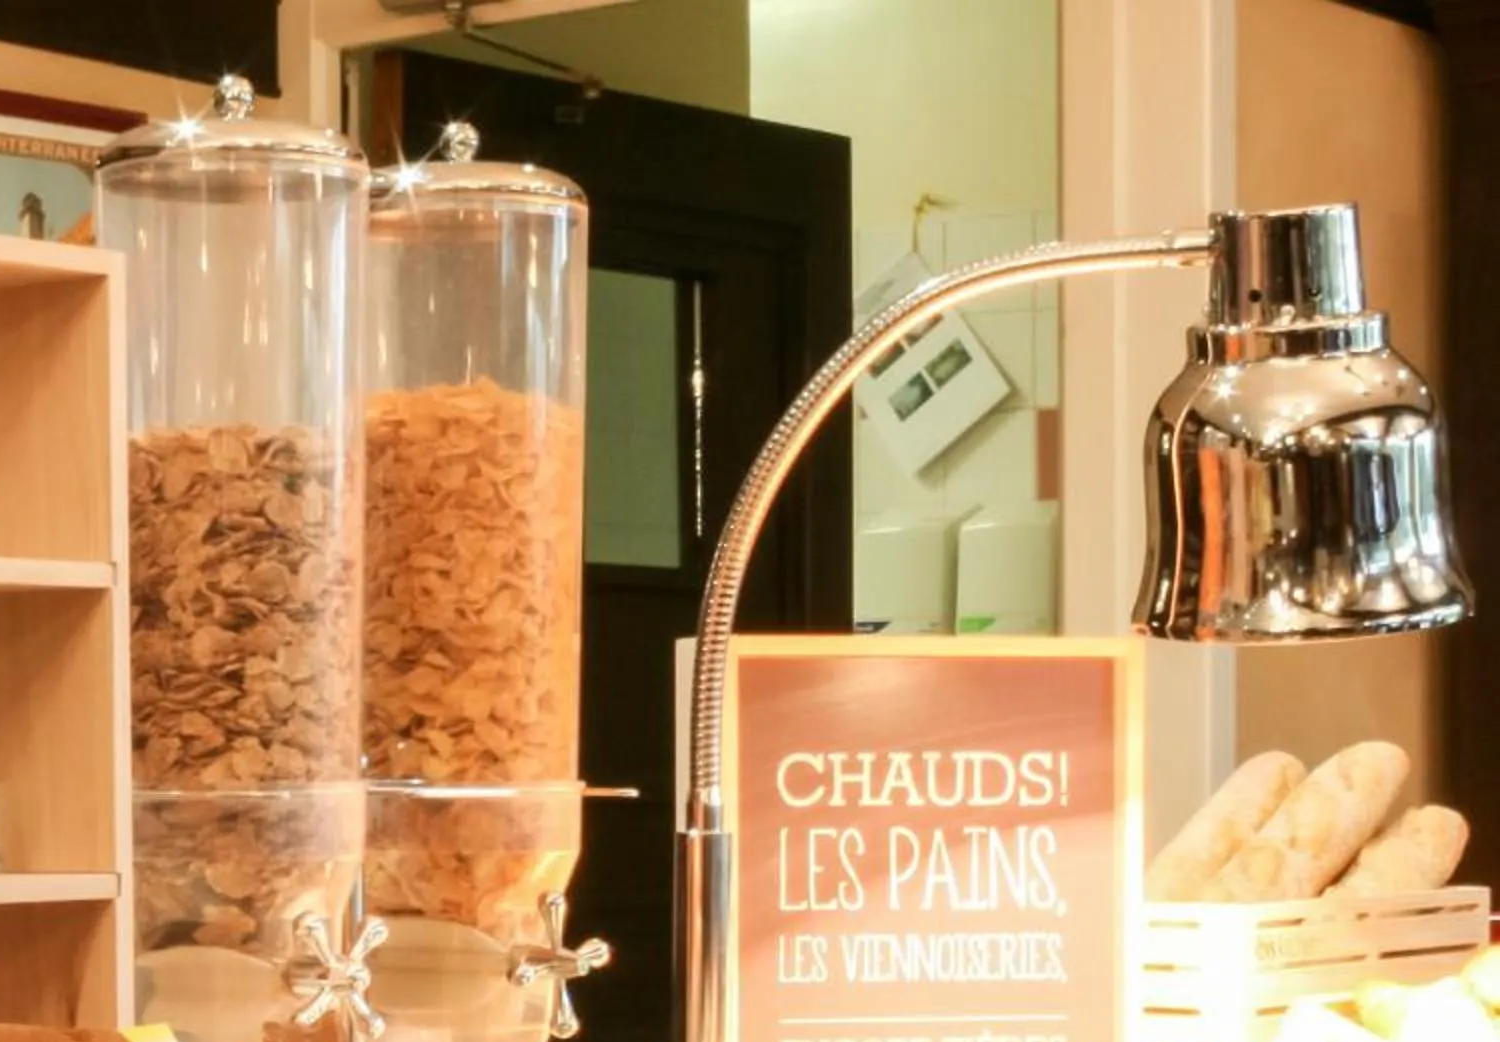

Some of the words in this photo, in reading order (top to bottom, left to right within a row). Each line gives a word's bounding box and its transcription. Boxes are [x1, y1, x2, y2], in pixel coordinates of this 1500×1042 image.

[776, 749, 1070, 808] CHAUDS!
[778, 828, 866, 913] LES
[888, 826, 1068, 917] PAINS,
[777, 935, 828, 984] LES
